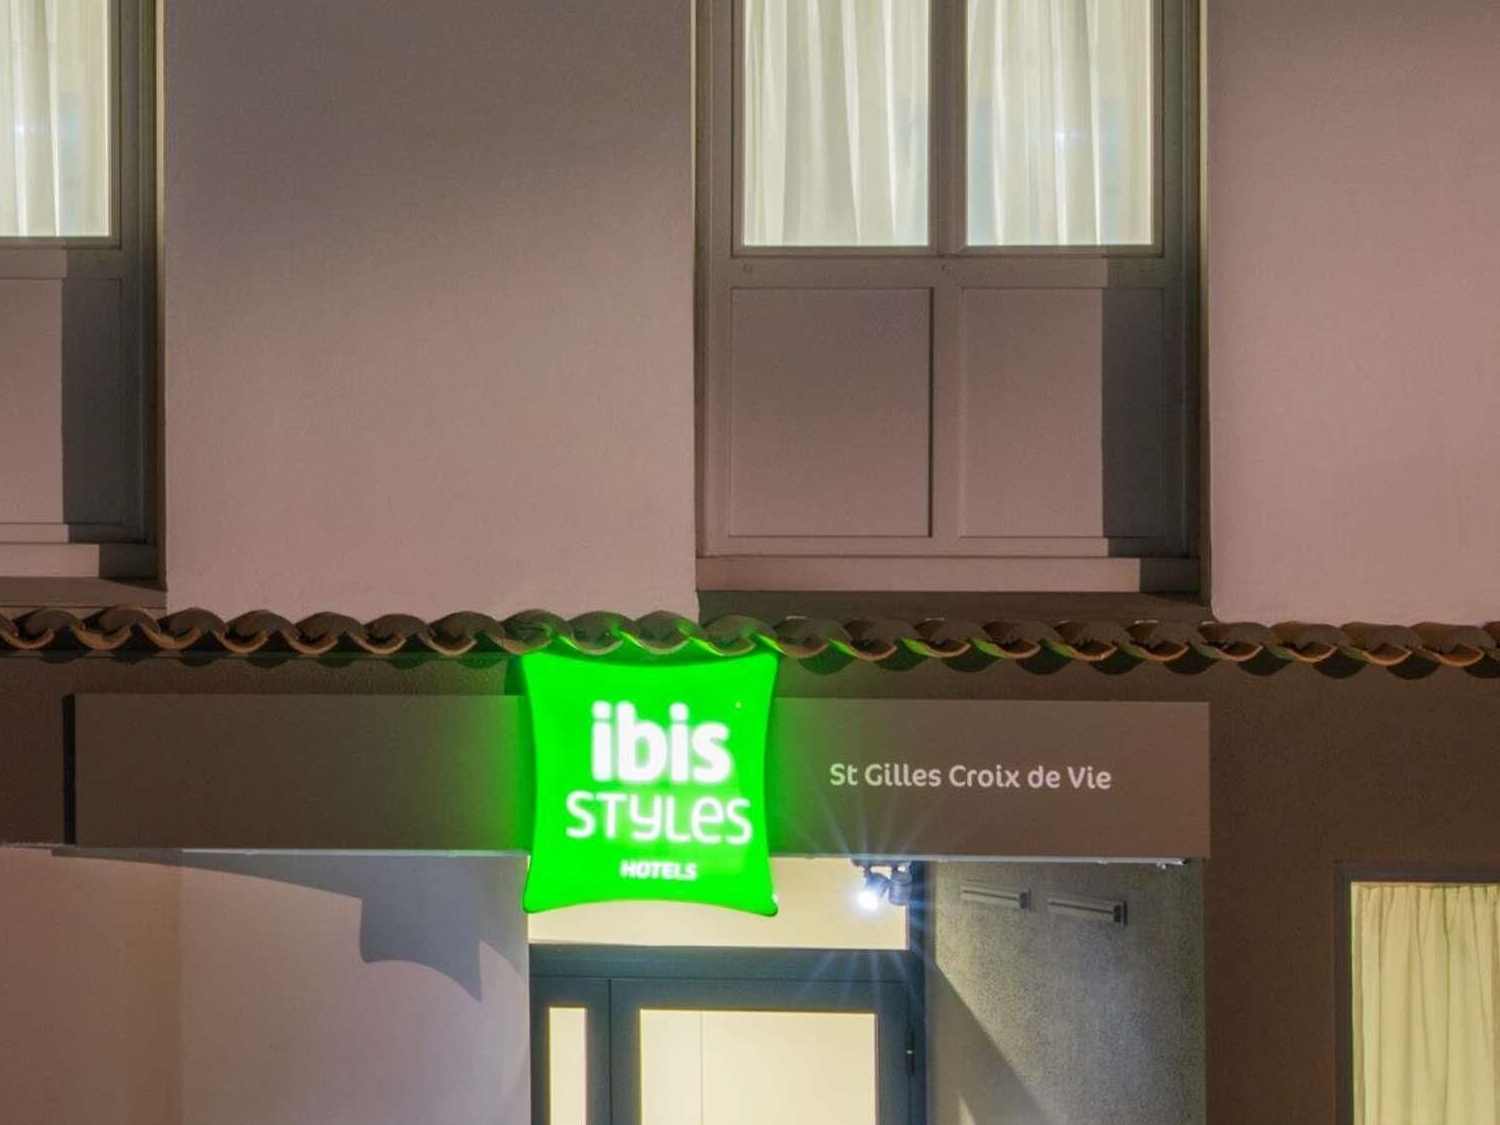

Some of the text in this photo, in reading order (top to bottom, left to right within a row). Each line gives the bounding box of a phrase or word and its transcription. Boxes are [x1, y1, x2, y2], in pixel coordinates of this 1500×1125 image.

[592, 701, 733, 783] ibis
[829, 762, 1112, 790] St Gilles Croix de Vie
[620, 860, 698, 880] HOTELS
